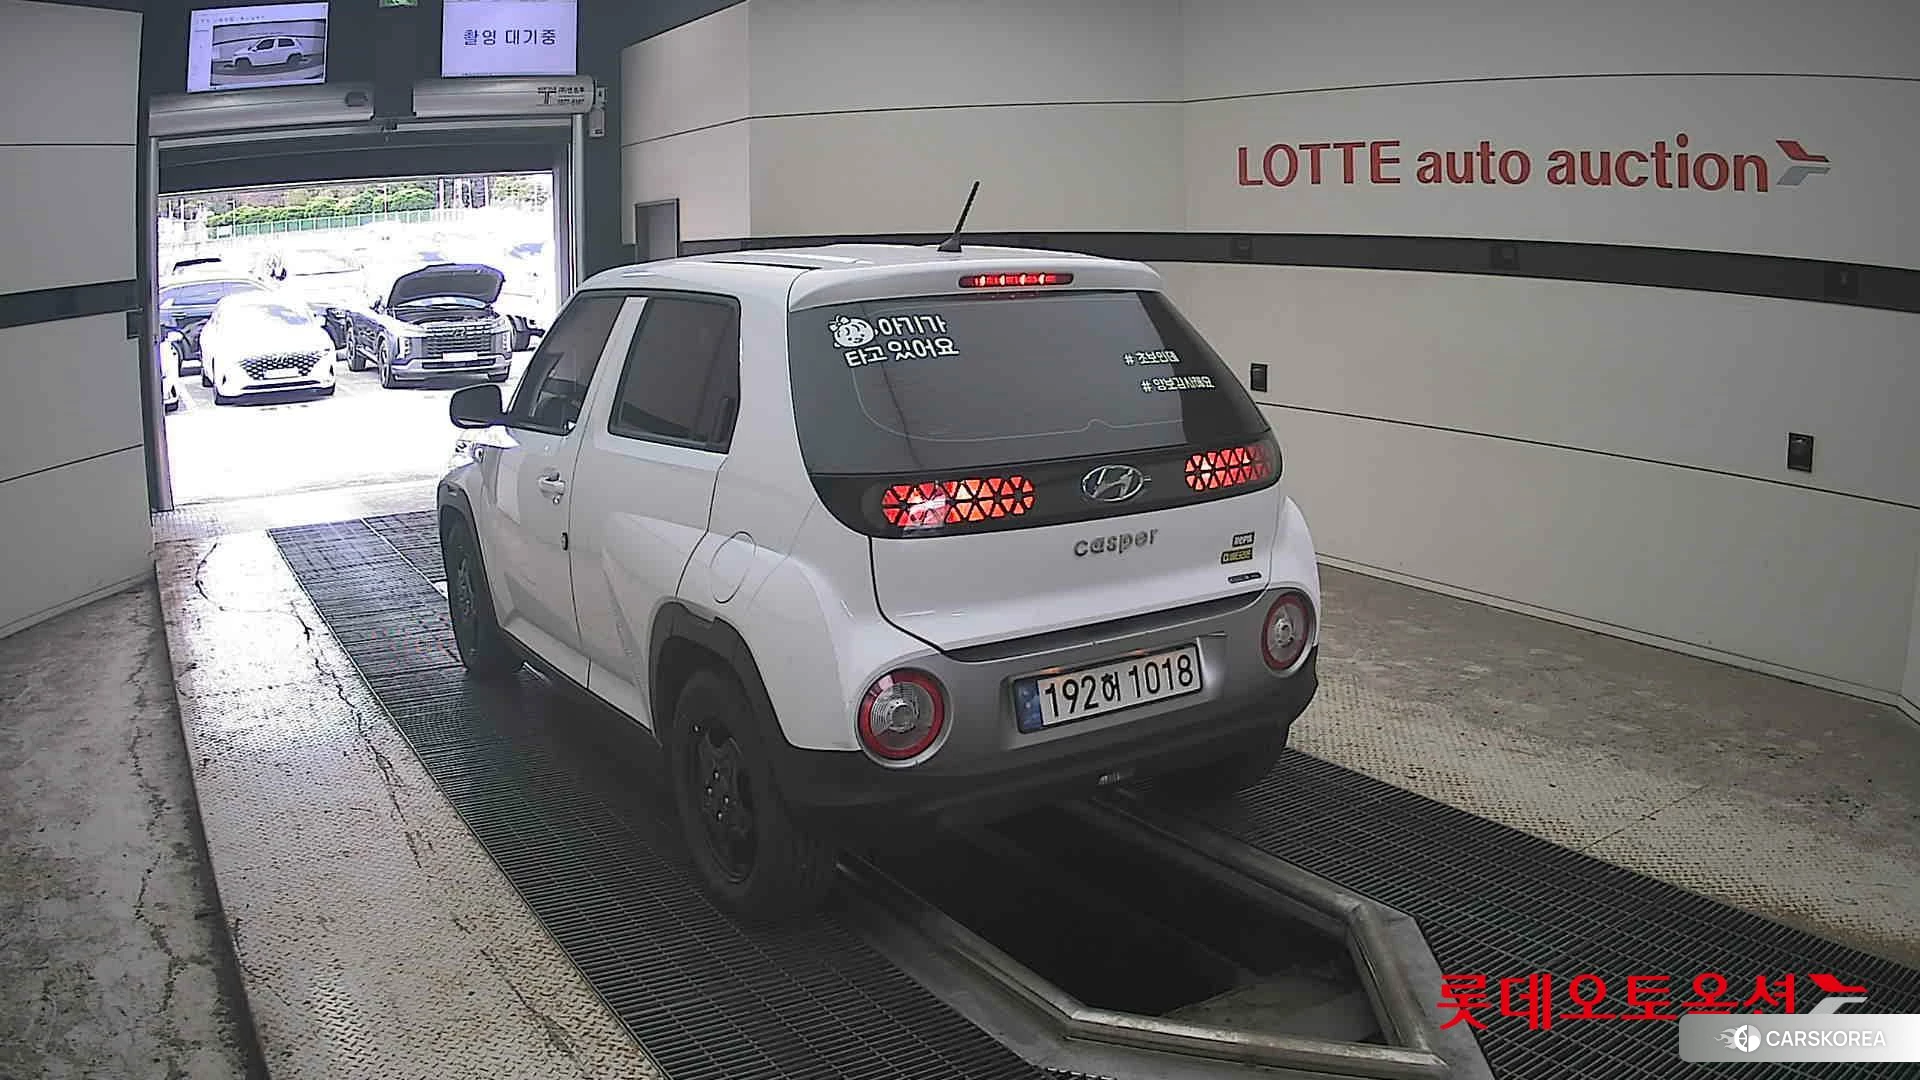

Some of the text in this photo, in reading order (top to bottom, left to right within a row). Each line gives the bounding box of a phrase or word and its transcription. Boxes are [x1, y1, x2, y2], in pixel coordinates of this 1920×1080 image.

[463, 29, 556, 46] 촬영 대기중
[1238, 133, 1769, 193] LOTTE auto auction
[878, 315, 946, 335] 아기가
[844, 337, 960, 367] 타고 있어요
[1073, 528, 1159, 557] casper
[1045, 654, 1194, 717] 192허 1018
